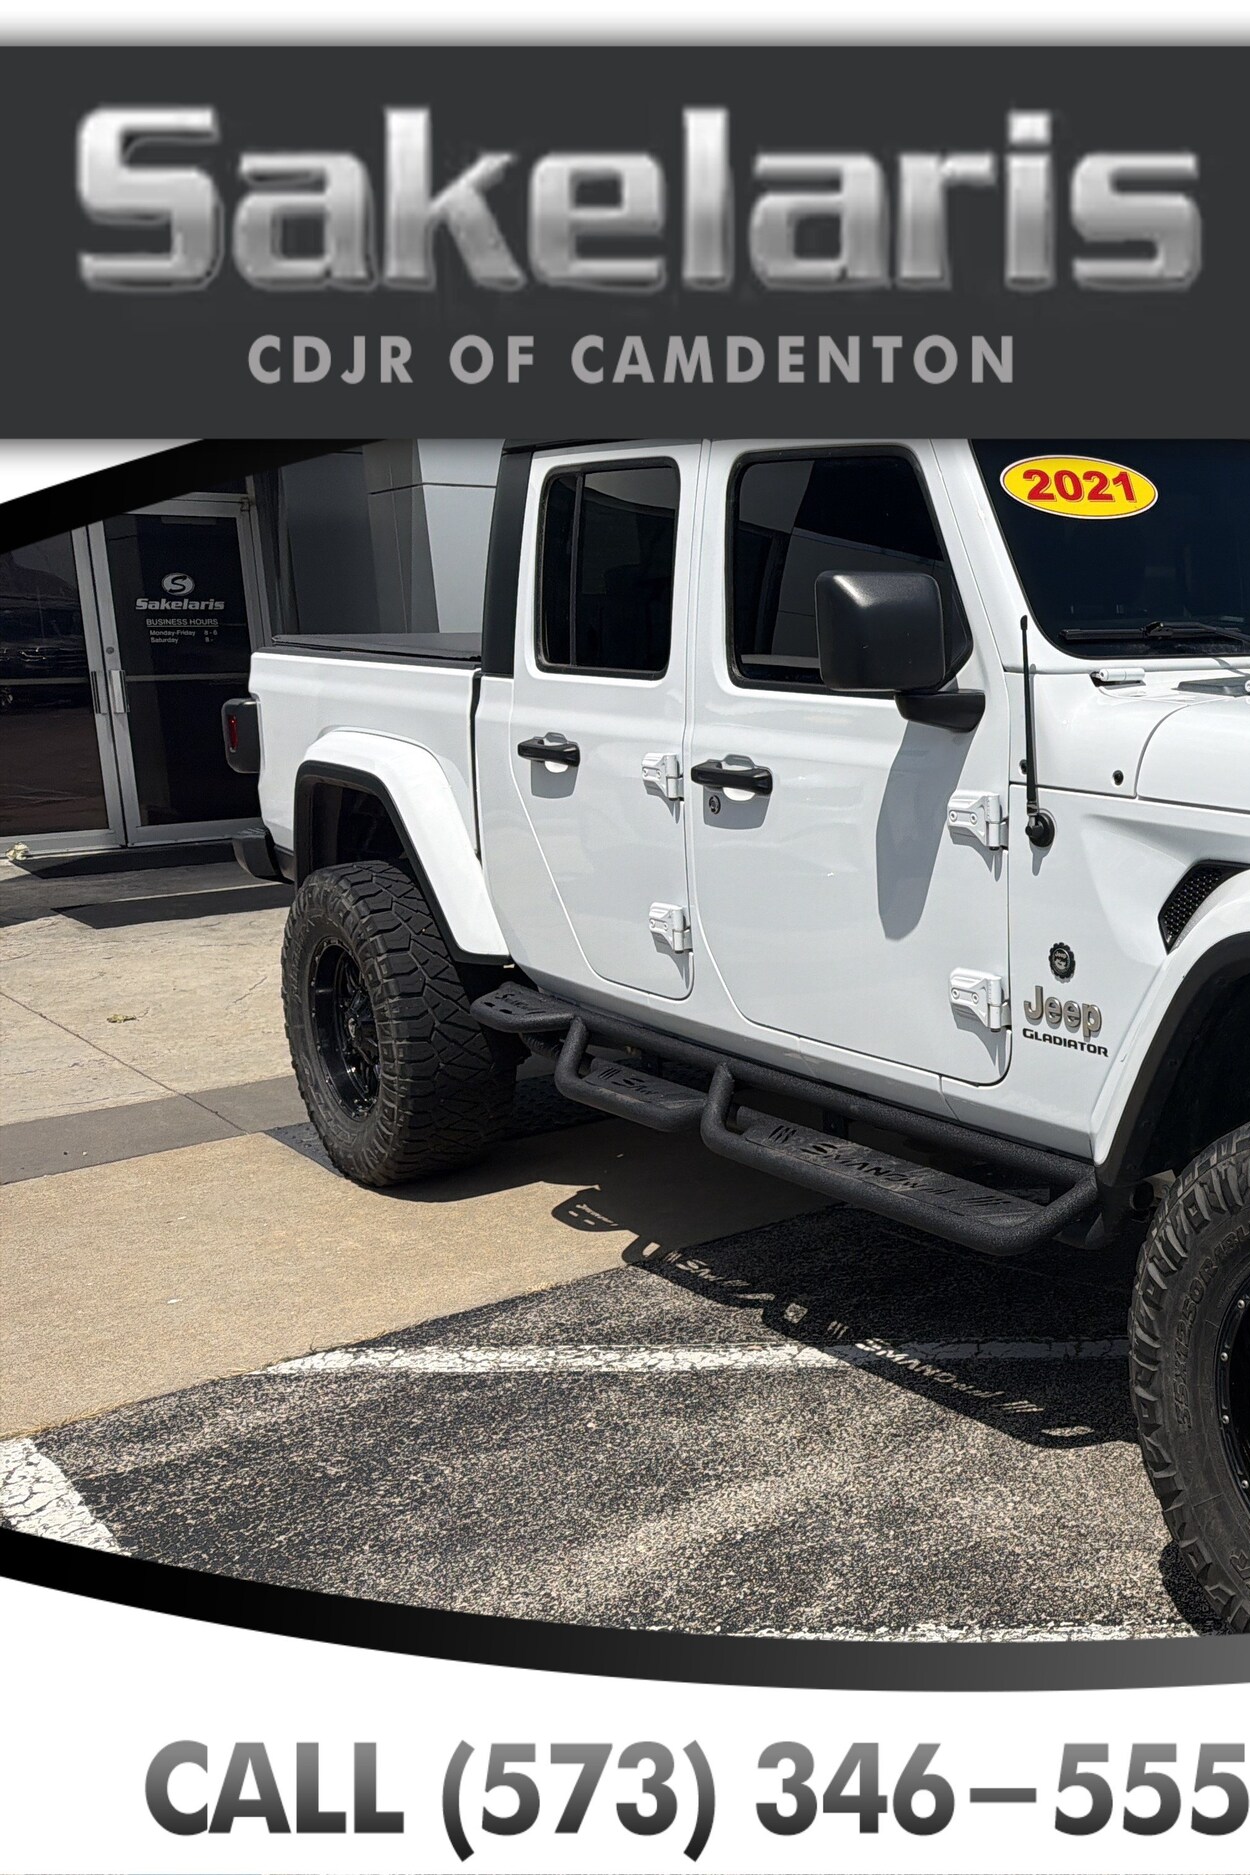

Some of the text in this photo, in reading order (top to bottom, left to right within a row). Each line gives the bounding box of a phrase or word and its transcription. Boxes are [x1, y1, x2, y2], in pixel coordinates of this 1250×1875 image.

[1022, 468, 1137, 503] 2021
[135, 598, 225, 610] Sakelaris
[146, 618, 218, 626] BUSINESS HOURS
[1023, 985, 1103, 1038] Jeep
[1022, 1027, 1109, 1058] GLADIATOR
